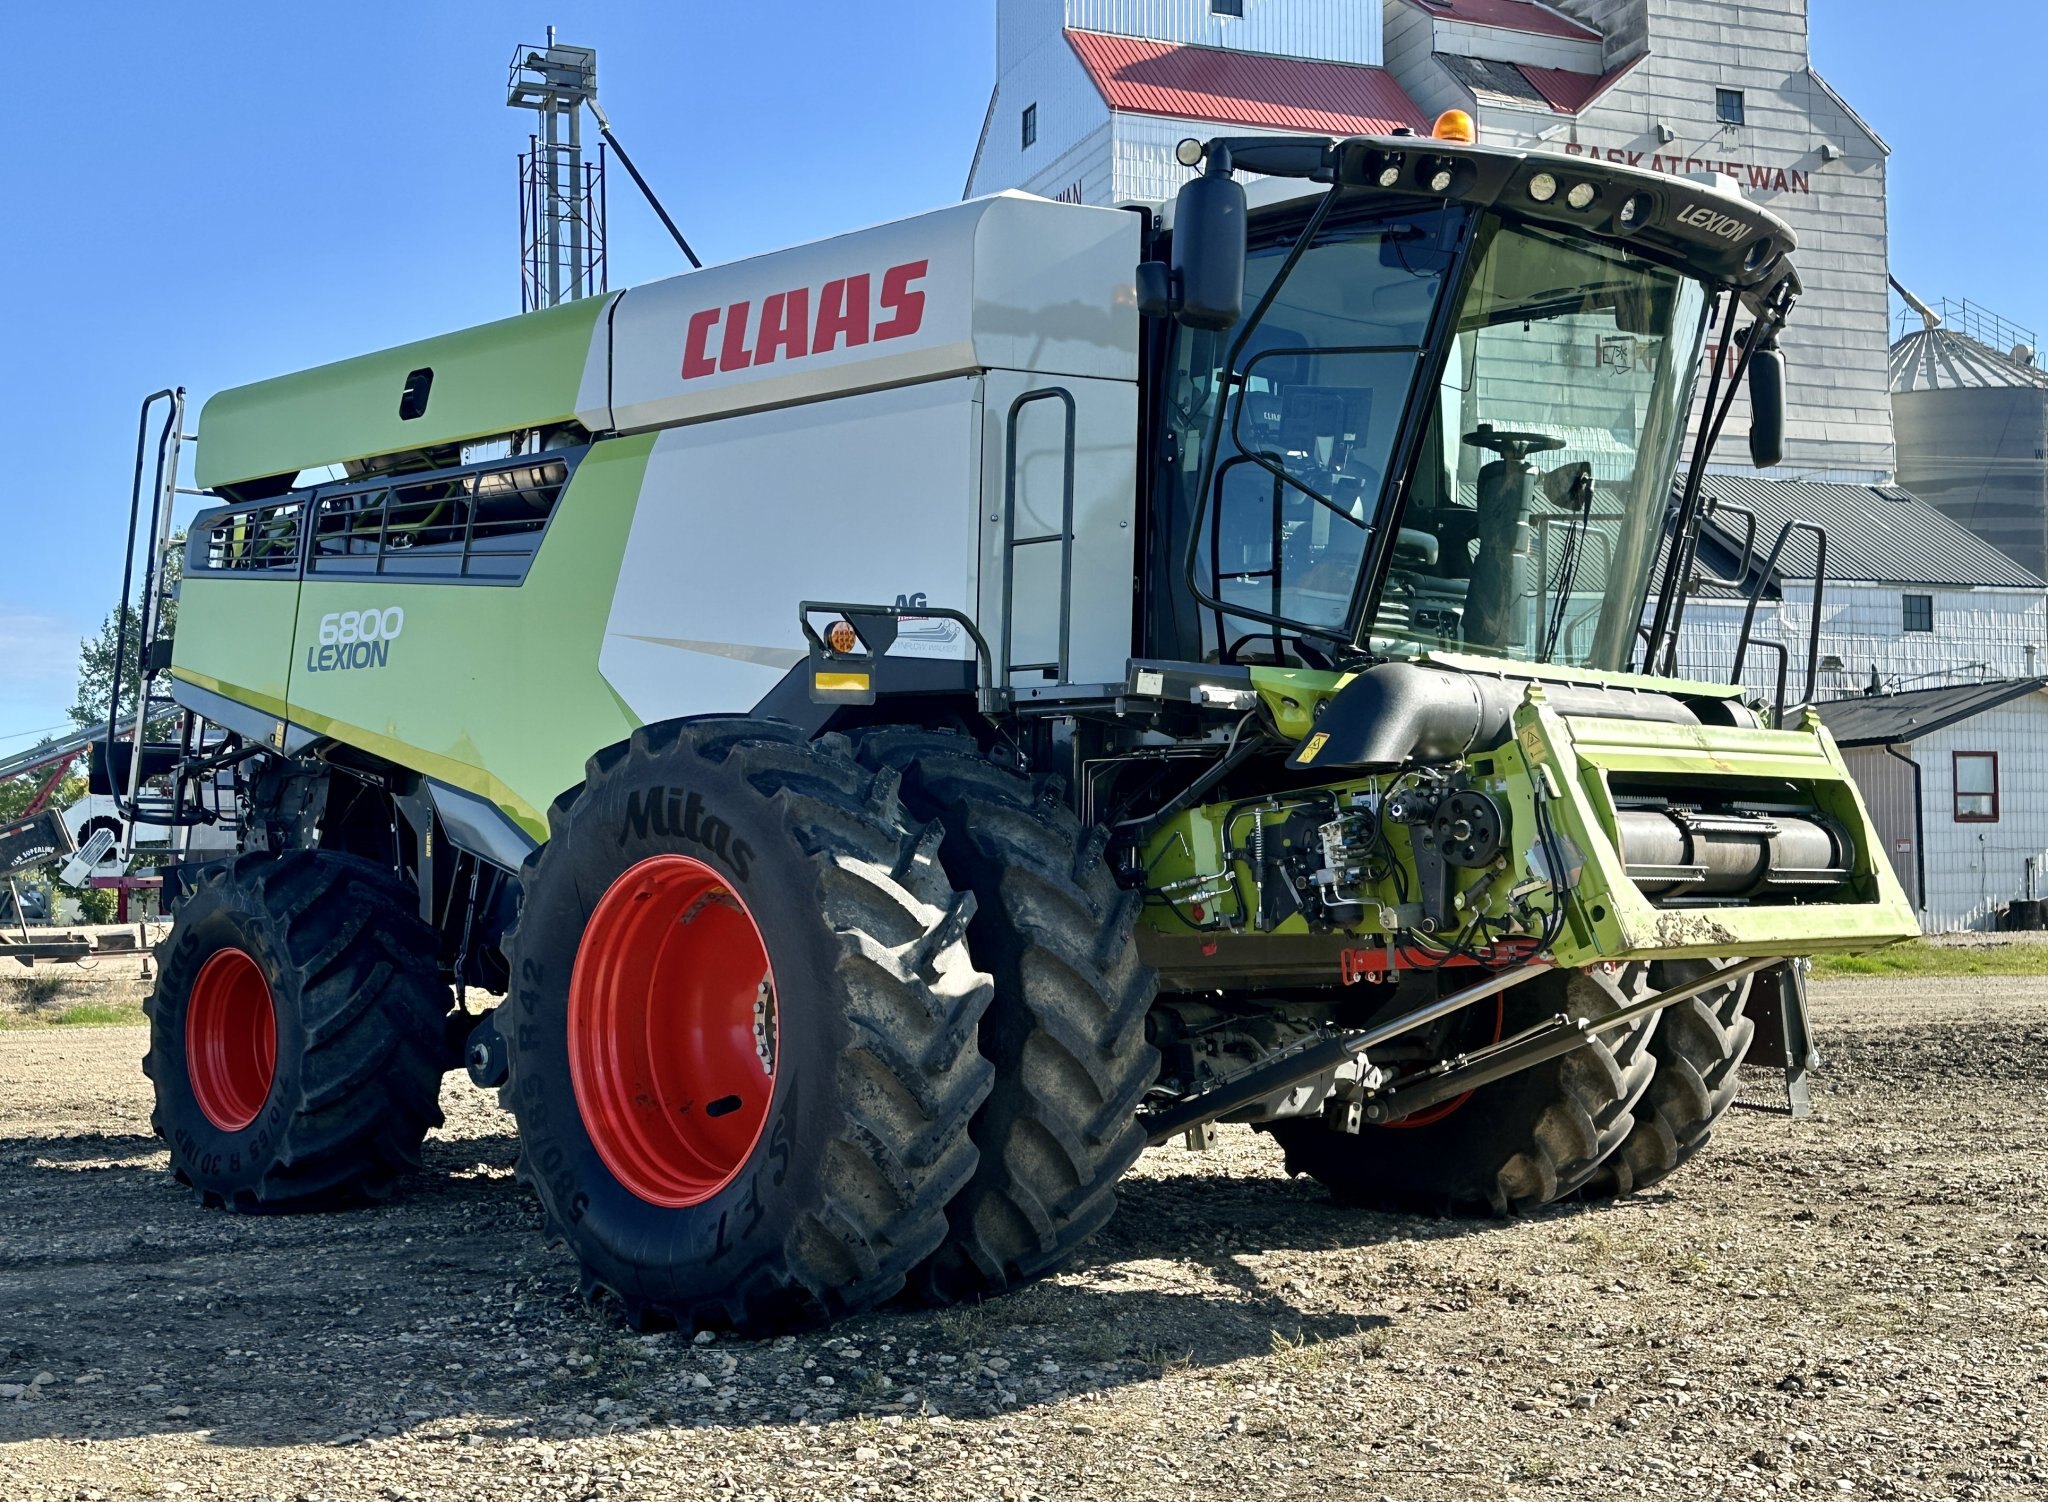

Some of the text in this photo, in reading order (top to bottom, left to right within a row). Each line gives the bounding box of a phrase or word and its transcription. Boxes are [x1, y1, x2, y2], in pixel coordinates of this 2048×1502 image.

[1676, 203, 1752, 242] LEXION
[682, 259, 929, 380] CLAAS
[319, 606, 404, 645] 6800
[307, 639, 390, 673] LEXION
[617, 785, 756, 884] Mitas
